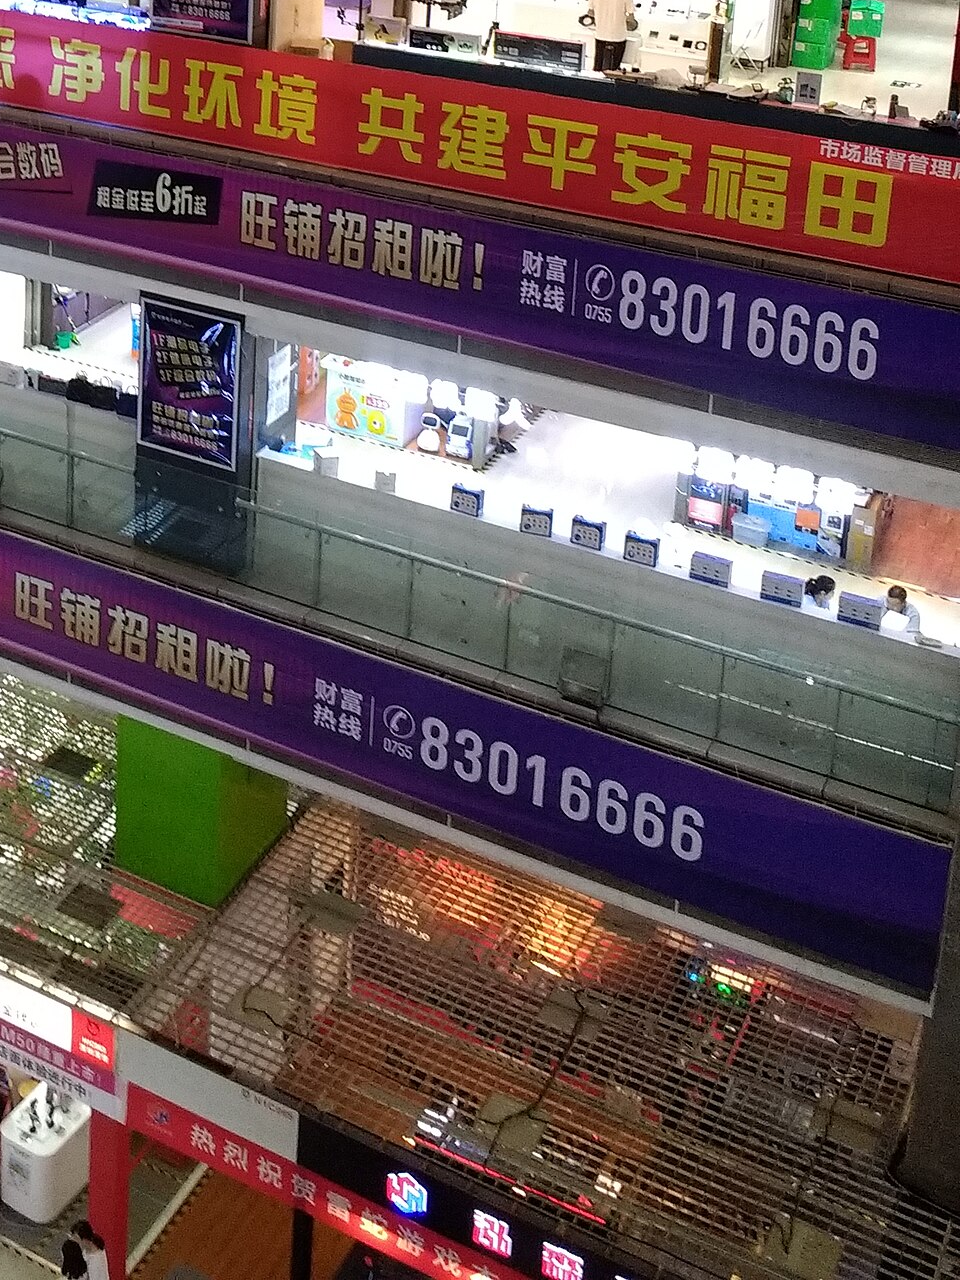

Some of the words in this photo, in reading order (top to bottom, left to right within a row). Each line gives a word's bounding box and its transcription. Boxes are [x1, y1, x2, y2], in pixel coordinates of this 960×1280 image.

[47, 33, 318, 147] 净化环境
[357, 86, 894, 248] 共建平安福田
[820, 138, 960, 180] 市场监督管理
[97, 171, 208, 217] 租金低至6折起
[522, 250, 567, 285] 财富
[584, 304, 613, 325] 0755
[619, 269, 880, 382] 83016666
[519, 279, 566, 315] 热线
[313, 703, 362, 742] 热线
[314, 677, 363, 713] 财富
[382, 736, 413, 761] 0755
[420, 716, 706, 862] 83016666
